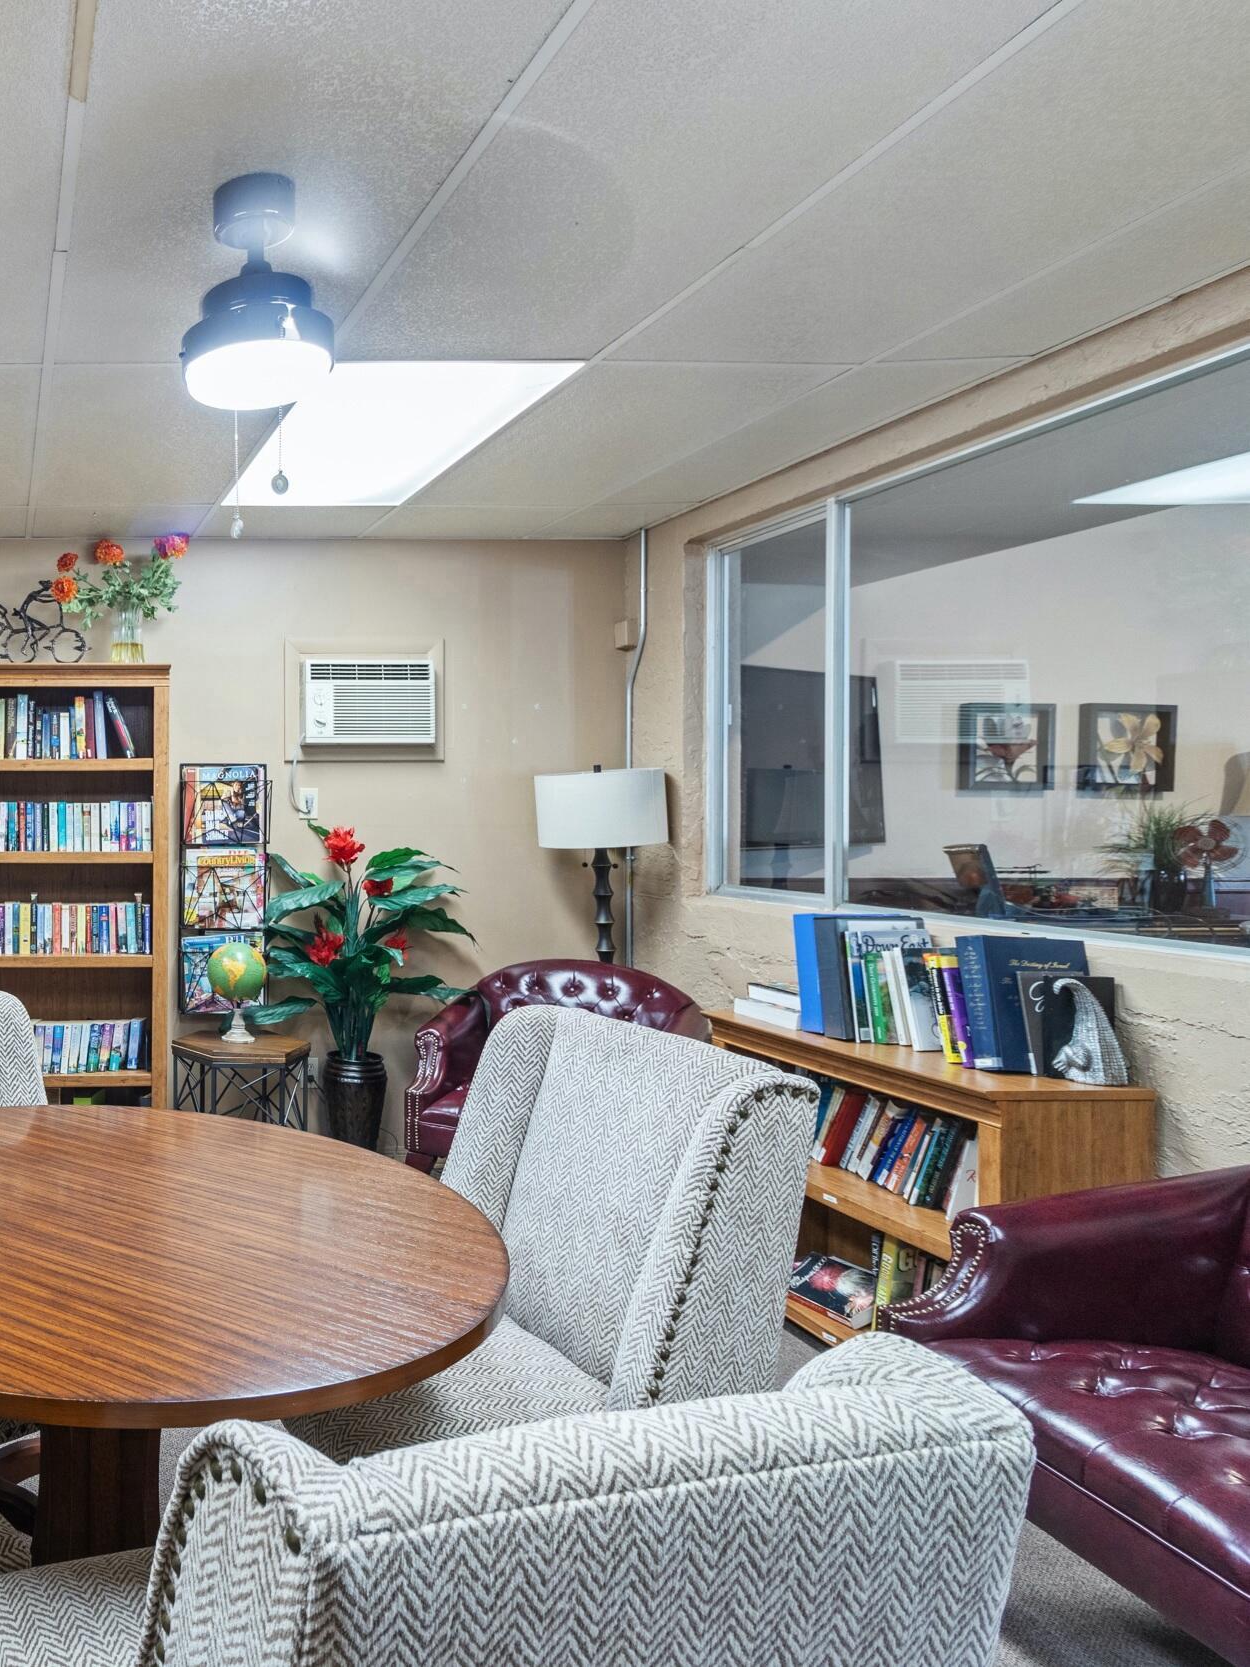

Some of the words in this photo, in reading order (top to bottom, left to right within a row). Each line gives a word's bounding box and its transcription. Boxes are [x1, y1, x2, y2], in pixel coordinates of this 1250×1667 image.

[202, 770, 256, 780] MAGNOLIA
[862, 934, 899, 952] Down
[901, 934, 929, 949] East
